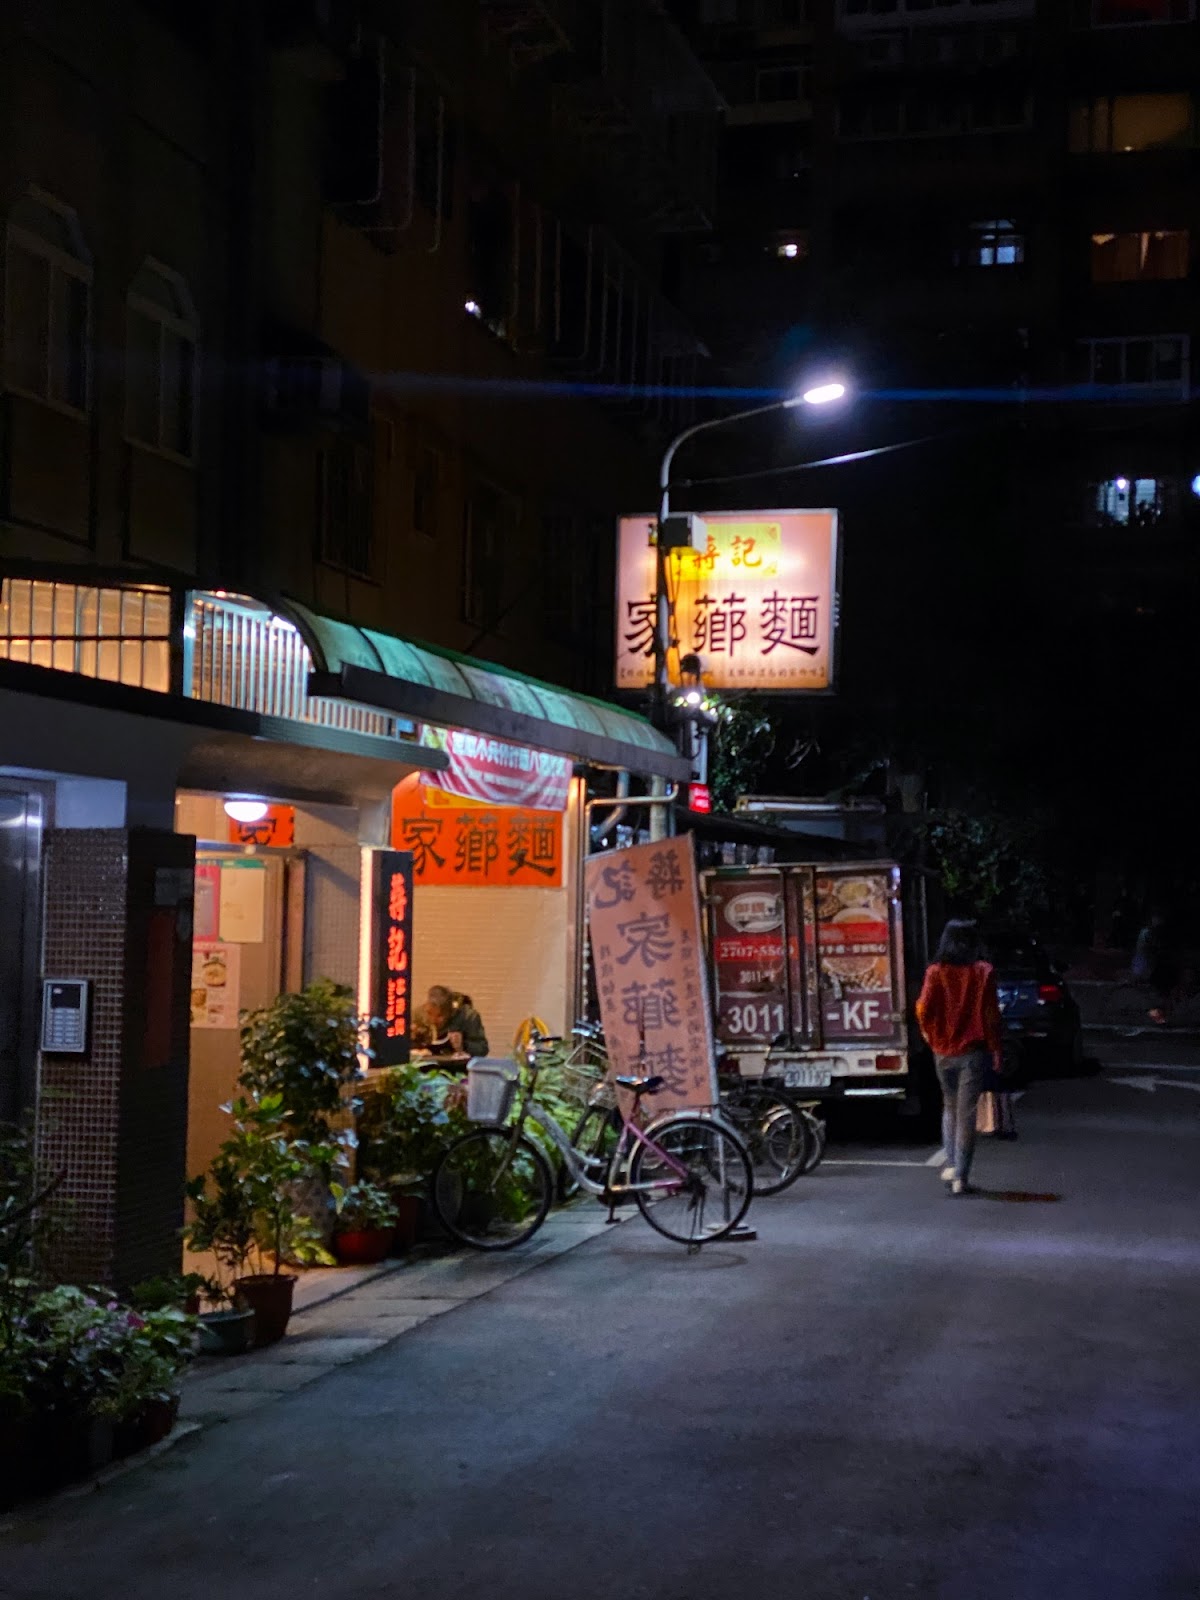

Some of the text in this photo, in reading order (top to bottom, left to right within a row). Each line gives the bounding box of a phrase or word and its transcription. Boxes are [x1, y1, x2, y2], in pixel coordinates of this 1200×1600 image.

[402, 810, 557, 878] 家薌麵
[727, 1004, 784, 1034] 3011
